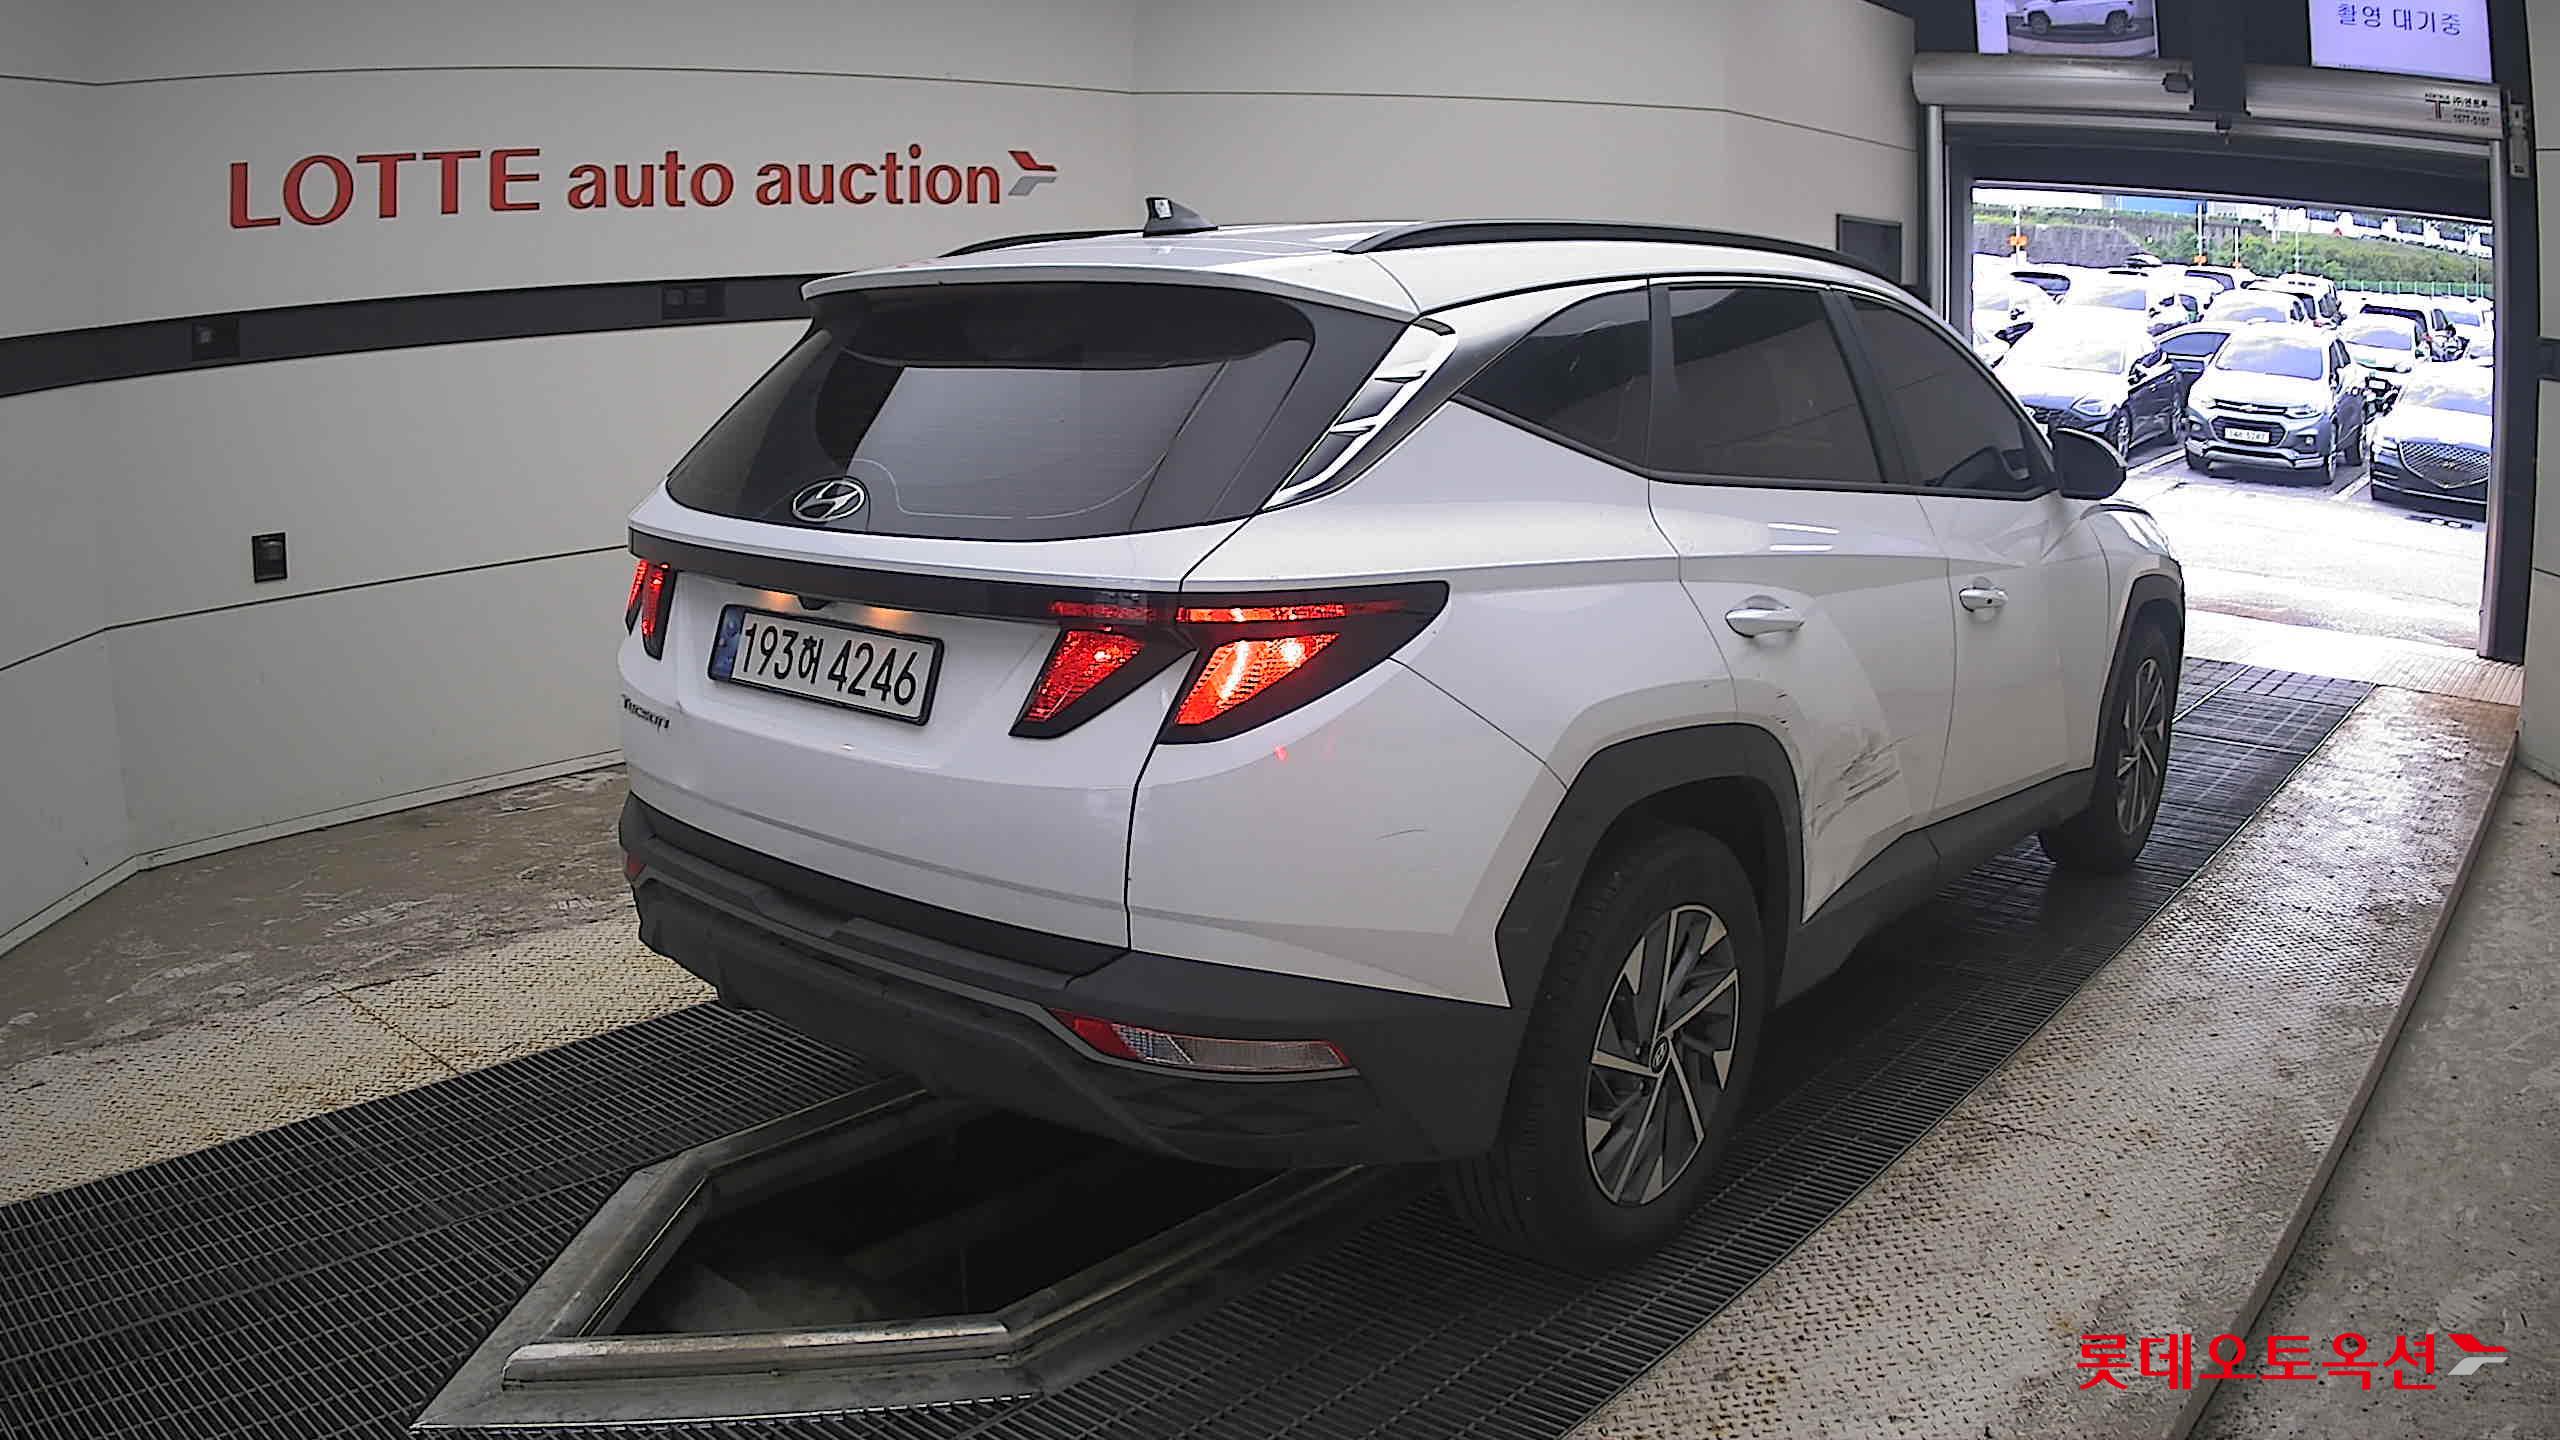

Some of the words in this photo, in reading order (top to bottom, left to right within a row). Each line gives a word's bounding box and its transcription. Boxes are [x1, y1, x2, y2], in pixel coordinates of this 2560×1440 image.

[2338, 3, 2381, 28] 촬영
[2393, 8, 2460, 36] 대기중
[228, 147, 540, 230] LOTTE
[566, 150, 735, 210] auto
[754, 143, 1002, 206] auction
[744, 622, 825, 684] 193허
[827, 638, 918, 706] 4246
